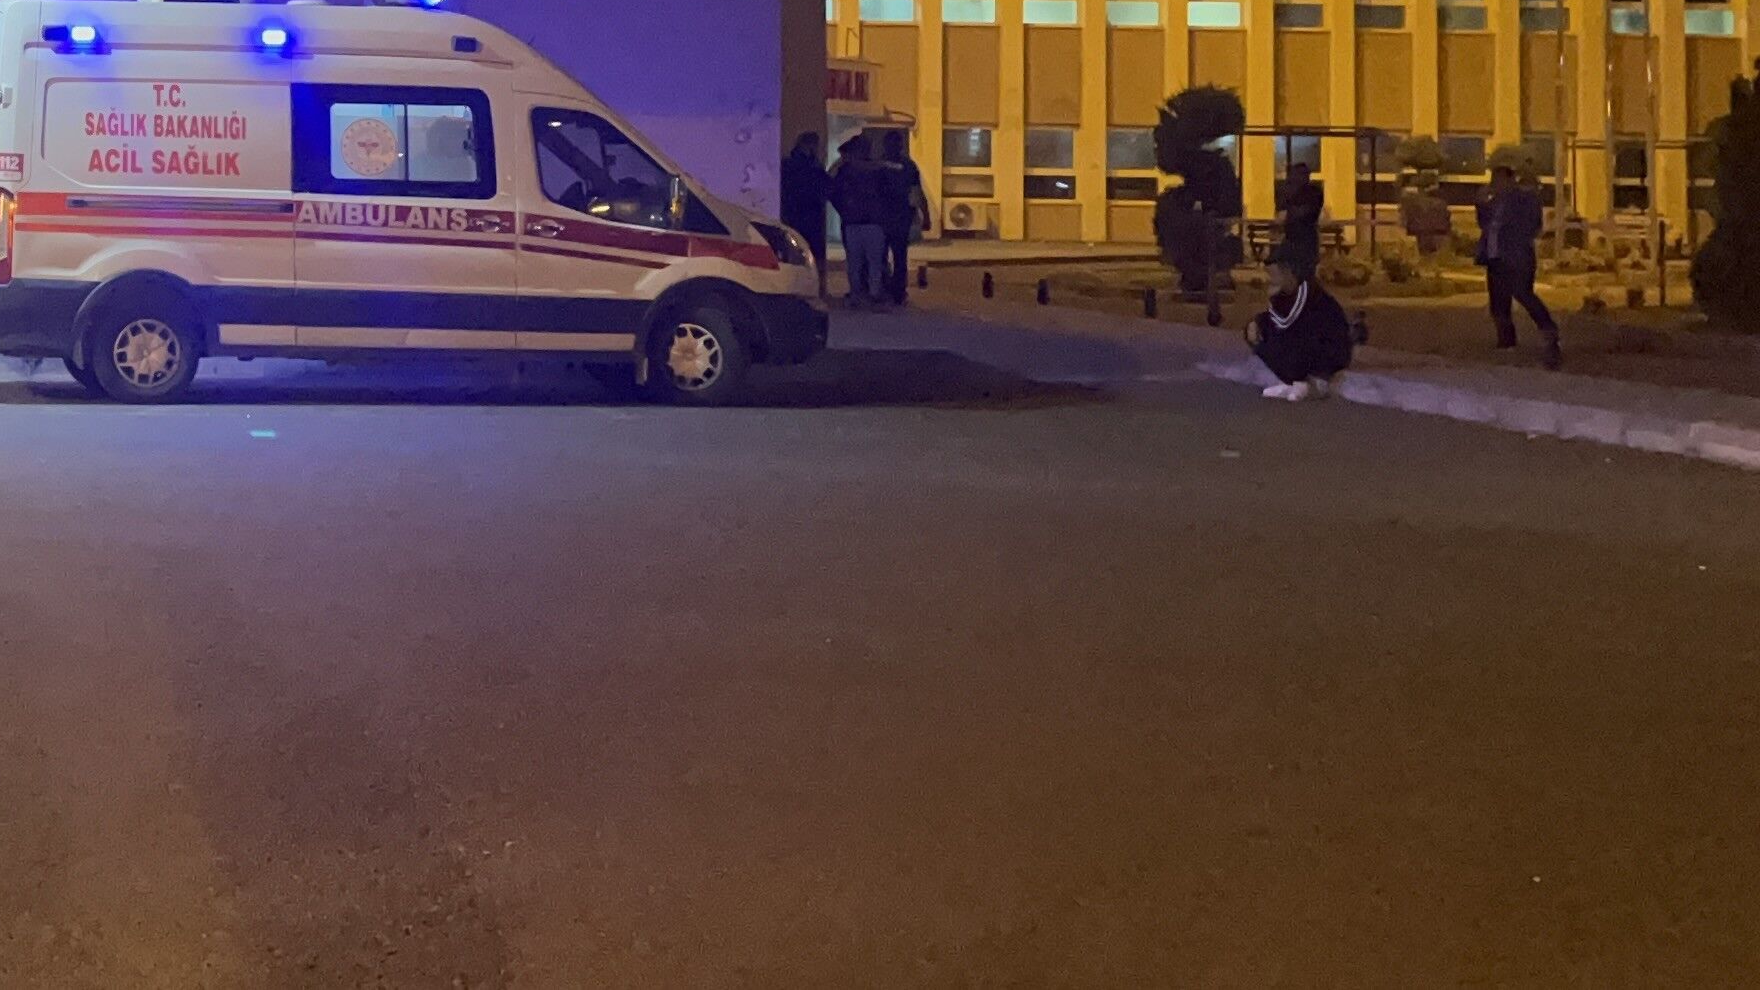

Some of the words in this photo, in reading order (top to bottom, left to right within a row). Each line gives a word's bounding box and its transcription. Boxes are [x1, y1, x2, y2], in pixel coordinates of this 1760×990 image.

[153, 84, 186, 107] T.C.
[85, 108, 147, 137] SAĞLIK
[154, 111, 247, 140] BAKANLIĞI
[0, 155, 21, 171] 112
[88, 144, 144, 174] ACİL
[151, 145, 241, 177] SAĞLIK
[297, 200, 469, 232] AMBULANS
